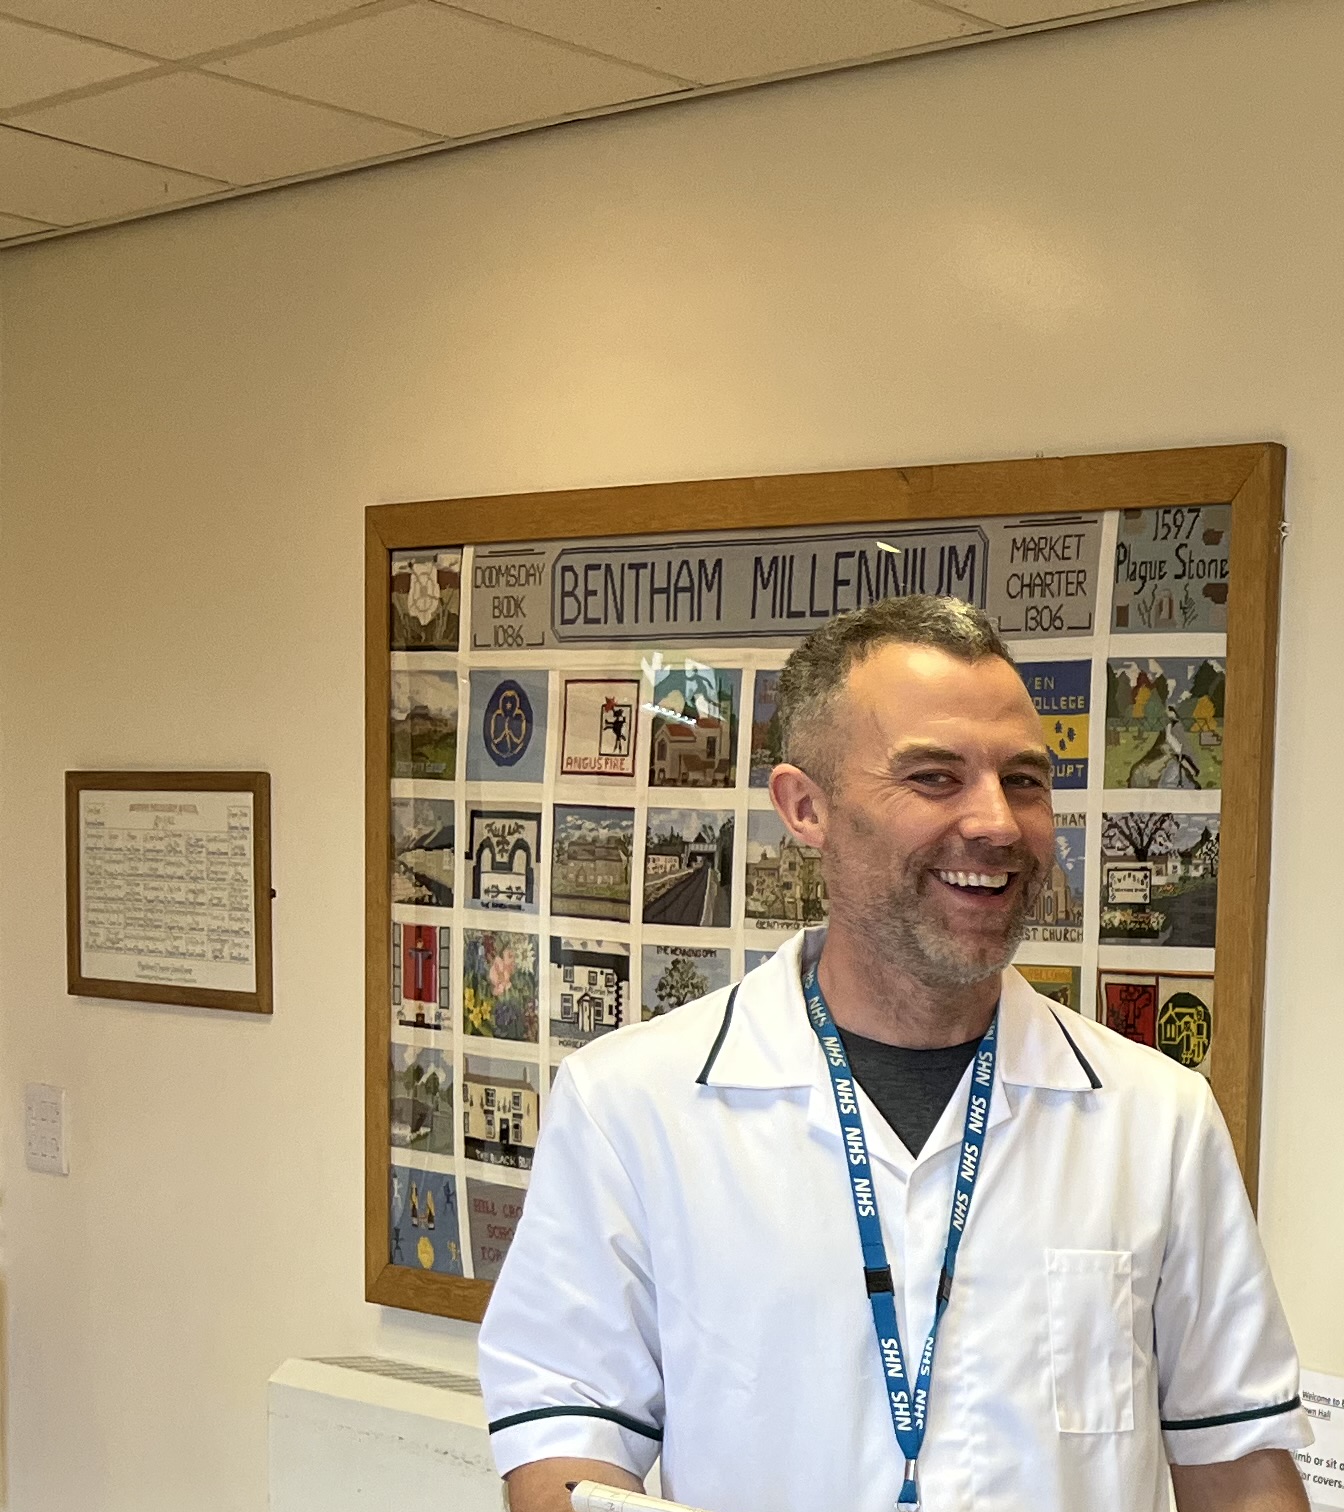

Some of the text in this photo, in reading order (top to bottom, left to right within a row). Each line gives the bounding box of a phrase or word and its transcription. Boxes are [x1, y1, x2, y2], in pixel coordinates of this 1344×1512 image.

[1153, 508, 1201, 541] 1597
[1010, 533, 1085, 563] MARKET
[474, 563, 545, 589] DOOMSDAY
[560, 544, 976, 625] BENTHAM MILLENNIUM
[1006, 569, 1087, 599] CHARTER
[1115, 542, 1230, 595] Plague Stone
[492, 595, 526, 618] BOOK
[1025, 603, 1064, 632] 1306
[493, 624, 524, 647] 1086
[566, 756, 602, 771] ANGUS
[822, 1036, 846, 1068] NHS
[976, 1051, 993, 1087] NHS
[835, 1078, 857, 1115] NHS
[969, 1095, 986, 1134] NHS
[844, 1126, 866, 1166] NHS
[961, 1142, 979, 1182] NHS
[853, 1177, 875, 1217] NHS
[952, 1193, 969, 1232] NHS
[881, 1338, 903, 1378] NHS
[921, 1336, 934, 1376] NHS
[891, 1390, 912, 1431] NHS
[1302, 1390, 1331, 1405] Welcome
[1333, 1398, 1340, 1406] to
[1318, 1407, 1331, 1419] Hall
[1314, 1458, 1324, 1466] or
[1326, 1457, 1337, 1469] sit
